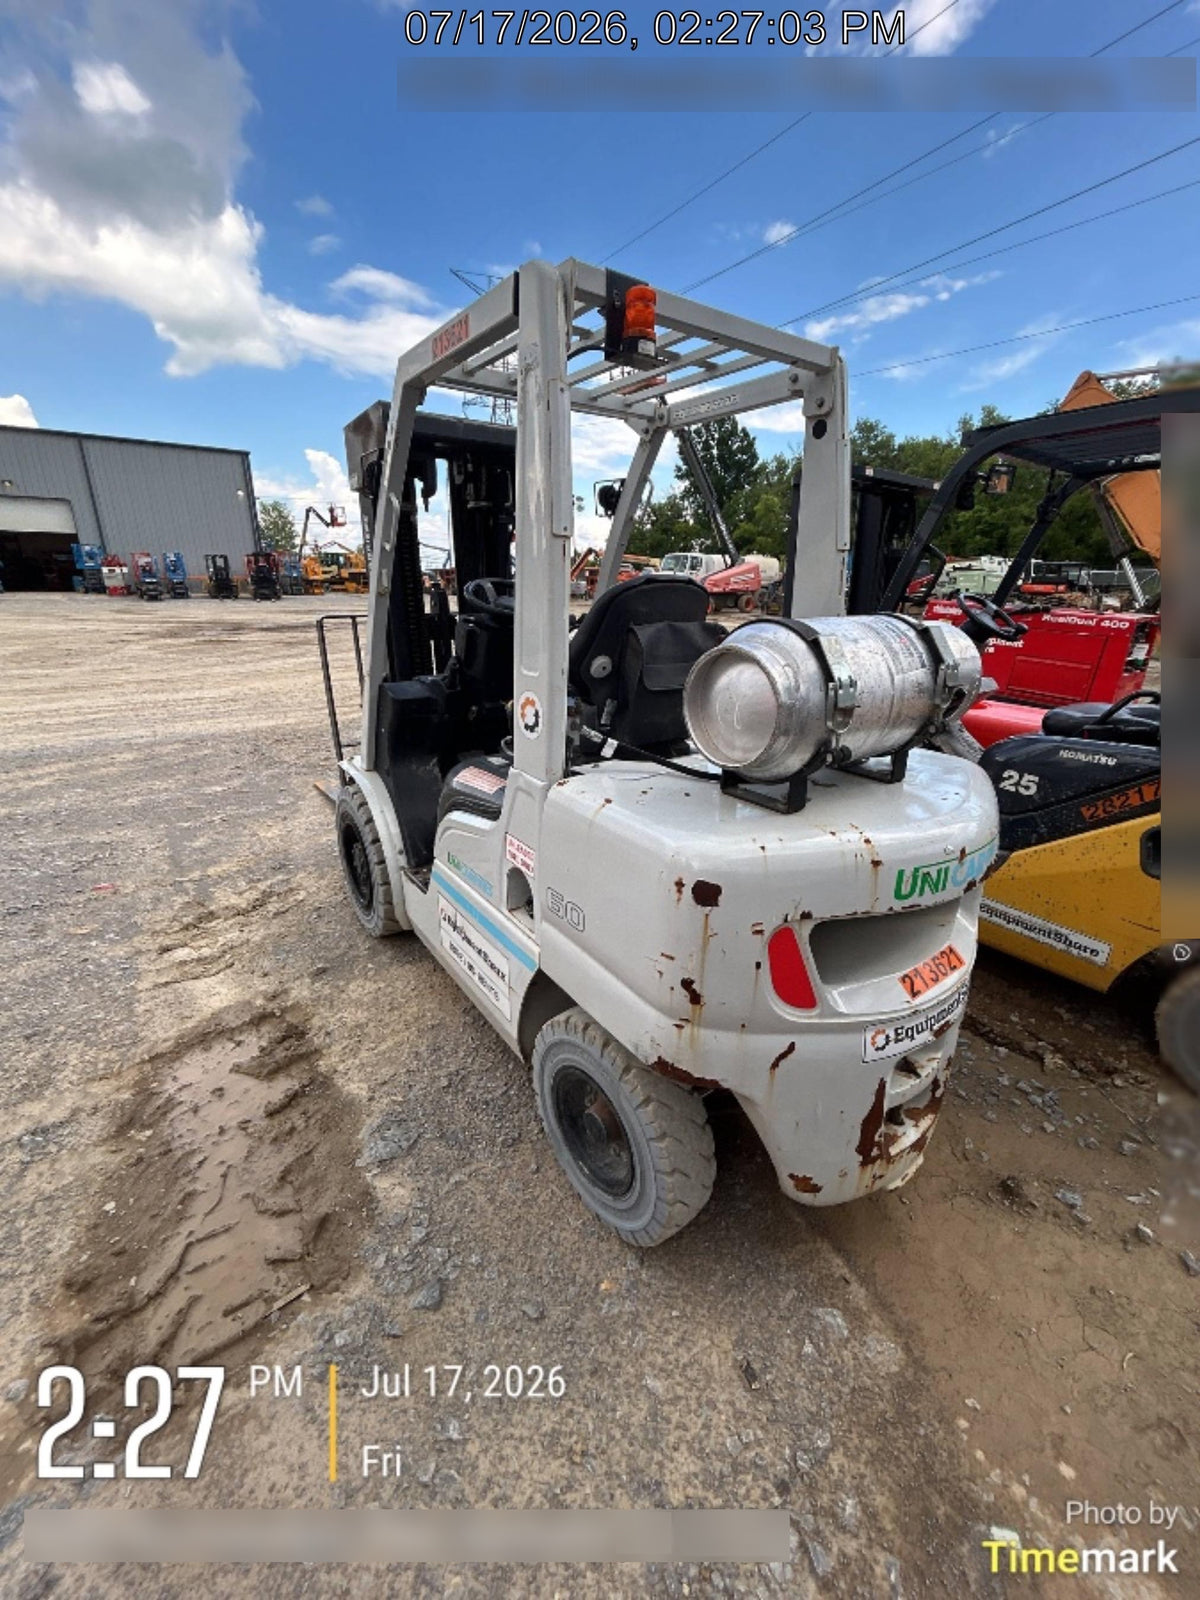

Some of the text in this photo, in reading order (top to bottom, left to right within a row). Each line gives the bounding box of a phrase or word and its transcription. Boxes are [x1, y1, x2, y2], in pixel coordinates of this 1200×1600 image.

[1100, 619, 1130, 629] 400
[1059, 749, 1118, 766] KOMATSU
[1000, 769, 1040, 796] 25
[901, 944, 964, 1000] 213621
